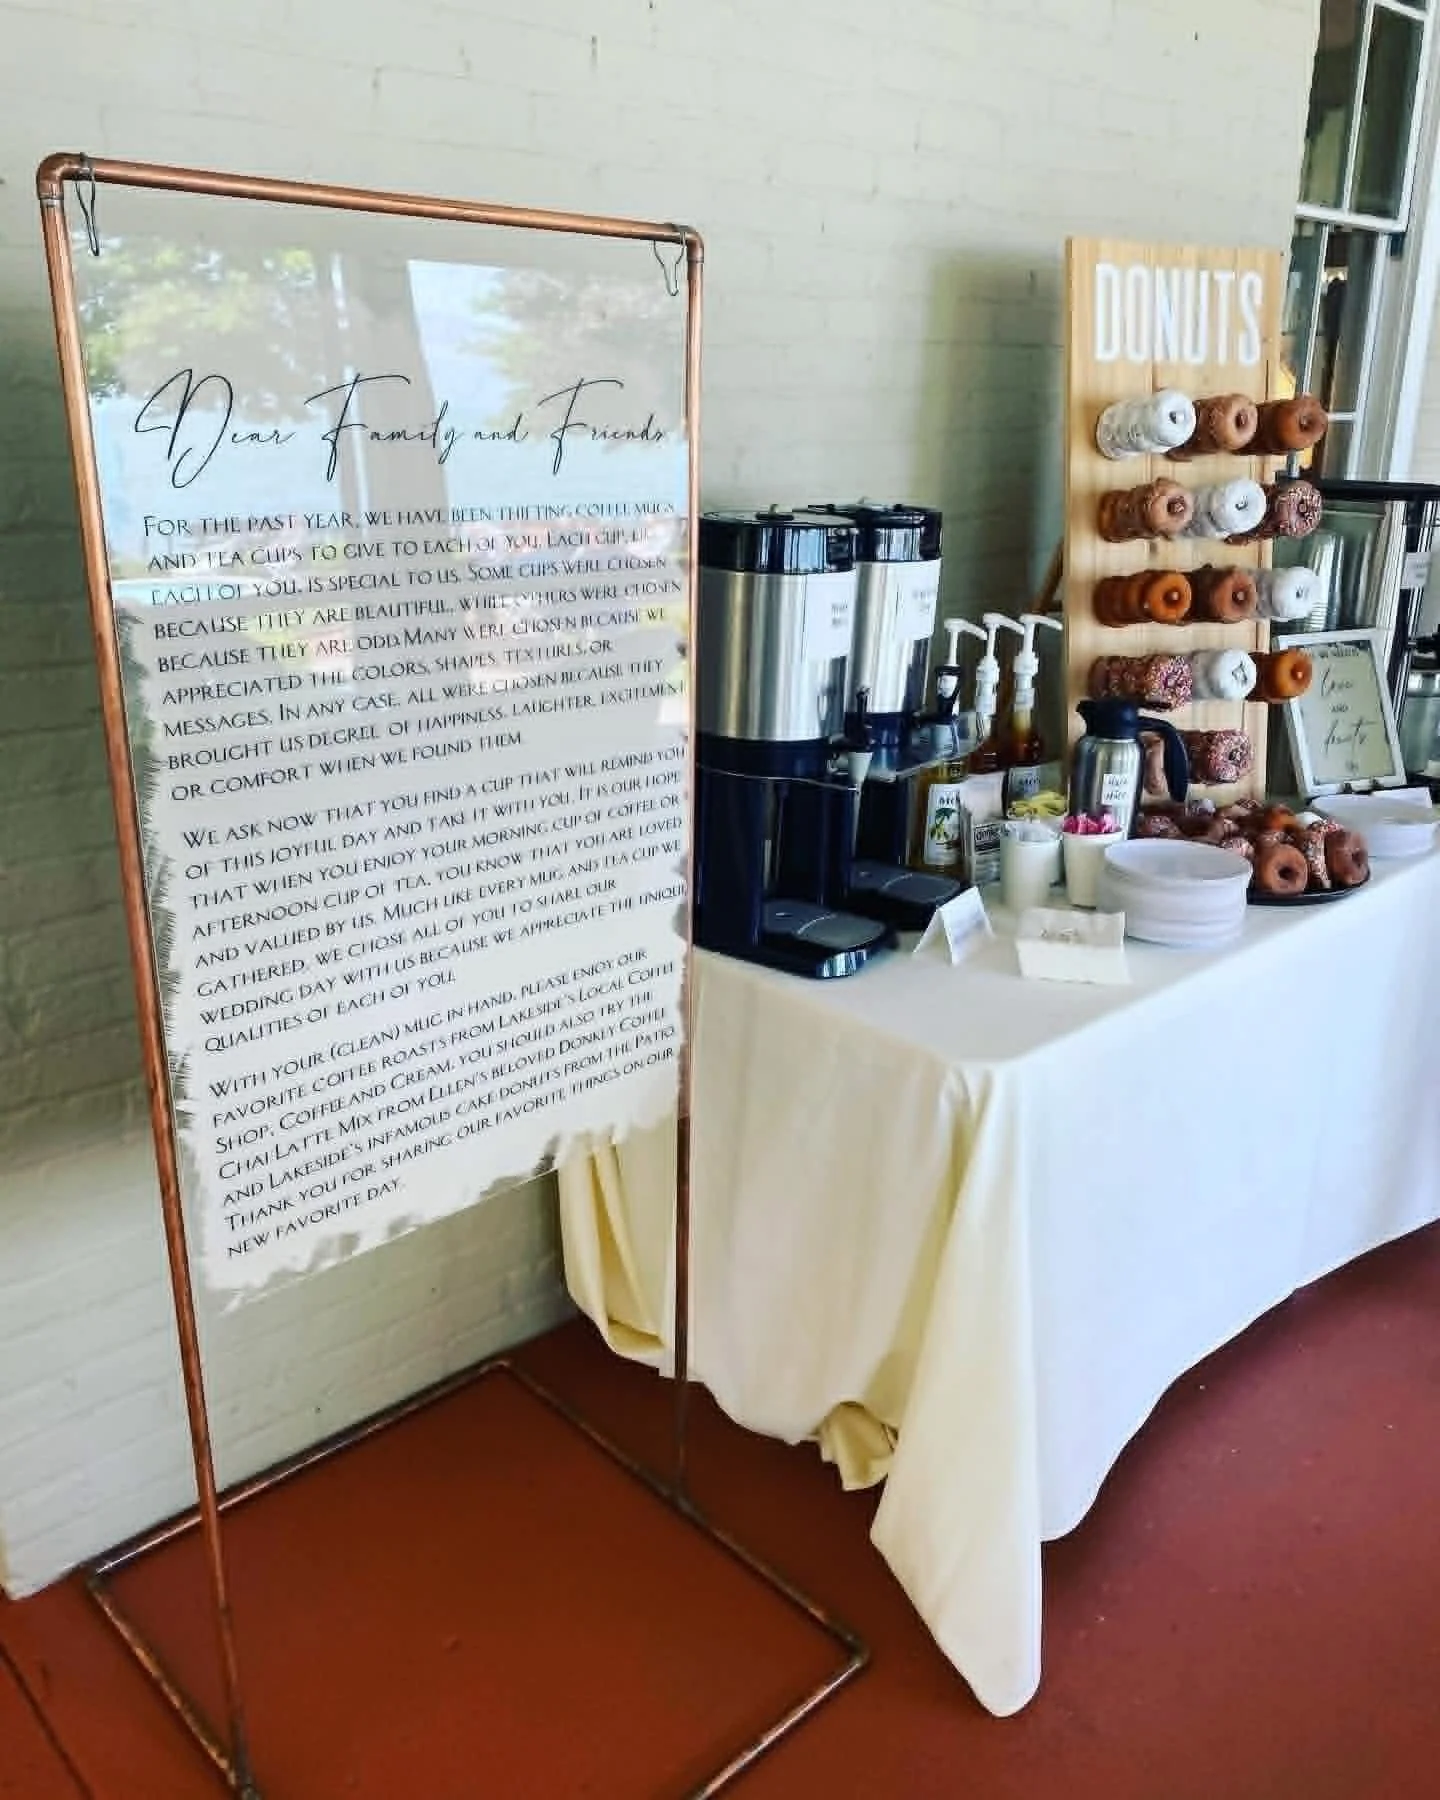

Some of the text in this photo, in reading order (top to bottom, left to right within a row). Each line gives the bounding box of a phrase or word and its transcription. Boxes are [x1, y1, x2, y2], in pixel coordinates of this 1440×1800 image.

[1095, 263, 1262, 366] DONUTS
[134, 368, 667, 488] Dear Family and Friends
[144, 516, 191, 536] FOR
[200, 517, 240, 533] THE
[248, 515, 296, 531] PAST
[365, 512, 392, 525] WE
[148, 553, 195, 571] AND
[312, 545, 336, 560] TO
[344, 543, 384, 558] GIVE
[392, 541, 417, 556] TO
[424, 538, 470, 554] EACH
[155, 617, 247, 639] BECAUSE
[312, 608, 350, 624] ARE
[581, 585, 618, 600] WERE
[308, 577, 323, 592] IS
[328, 573, 400, 591] SPECIAL
[408, 571, 432, 584] TO
[519, 561, 557, 576] CUPS
[562, 560, 600, 575] WERE
[158, 649, 248, 672] BECAUSE
[256, 643, 307, 660] THEY
[404, 628, 456, 648] MANY
[162, 640, 613, 704] APPRECIATED THE OR
[279, 704, 299, 720] IN
[307, 699, 344, 718] ANY
[408, 688, 436, 704] ALL
[442, 682, 487, 698] WERE
[493, 672, 556, 693] CHOSEN
[167, 741, 272, 770] BROUGHT
[280, 736, 302, 752] US
[171, 732, 520, 800] OR COMFORT WHEN WE FOUND THEM
[183, 831, 219, 848] WE
[225, 824, 260, 840] ASK
[267, 813, 316, 832] NOW
[326, 802, 375, 824] THAT
[381, 794, 417, 812] YOU
[424, 788, 460, 805] FIND
[467, 784, 476, 796] A
[482, 777, 512, 792] CUP
[521, 768, 562, 786] THAT
[564, 763, 596, 776] WILL
[223, 853, 264, 872] THIS
[271, 840, 336, 864] JOYFUL
[343, 832, 376, 848] DAY
[384, 822, 421, 839] AND
[474, 808, 487, 820] IT
[495, 800, 534, 816] WITH
[579, 785, 593, 800] IT
[611, 778, 641, 792] OUR
[190, 885, 247, 908] THAT
[253, 872, 312, 894] WHEN
[319, 862, 357, 880] YOU
[364, 849, 414, 872] ENJOY
[421, 840, 466, 860] YOUR
[471, 824, 548, 847] MORNING
[552, 816, 581, 831] CUP
[192, 897, 317, 939] AFTERNOON
[324, 889, 360, 908] CUP
[437, 864, 470, 880] YOU
[476, 853, 521, 872] KNOW
[532, 841, 568, 860] THAT
[195, 860, 598, 968] AND VALUED BY MUCH LIKE EVERY AND
[316, 949, 342, 965] WE
[414, 924, 439, 939] ALL
[471, 906, 504, 926] YOU
[513, 900, 532, 915] TO
[586, 880, 616, 896] OUR
[200, 992, 293, 1024] WEDDING
[300, 978, 336, 1000] DAY
[343, 963, 388, 984] WITH
[395, 958, 414, 972] US
[420, 936, 487, 964] BECAUSE
[204, 1016, 302, 1051] QUALITIES
[337, 992, 384, 1015] EACH
[209, 1072, 265, 1097] WITH
[271, 1053, 325, 1080] YOUR
[330, 1026, 400, 1060] (CLEAN)
[405, 1013, 442, 1032] MUG
[447, 1008, 462, 1022] IN
[213, 1086, 304, 1128] FAVORITE
[382, 1040, 448, 1069] ROASTS
[451, 1021, 493, 1044] FROM
[579, 976, 623, 1002] LOCAL
[280, 1011, 593, 1130] COFFEE AND YOU ALSO
[218, 1152, 268, 1179] CHAI
[276, 1129, 330, 1160] LATTE
[338, 1115, 372, 1136] MIX
[379, 1096, 424, 1120] FROM
[223, 1183, 263, 1206] AND
[455, 1093, 492, 1114] CAKE
[565, 1052, 602, 1076] FROM
[636, 1026, 674, 1048] PATIO
[224, 1200, 294, 1231] THANK
[298, 1177, 336, 1200] YOU
[382, 1136, 450, 1168] SHARING
[457, 1119, 490, 1138] OUR
[623, 1060, 642, 1074] ON
[647, 1048, 673, 1064] OUR
[229, 1195, 360, 1256] NEW FAVORITE
